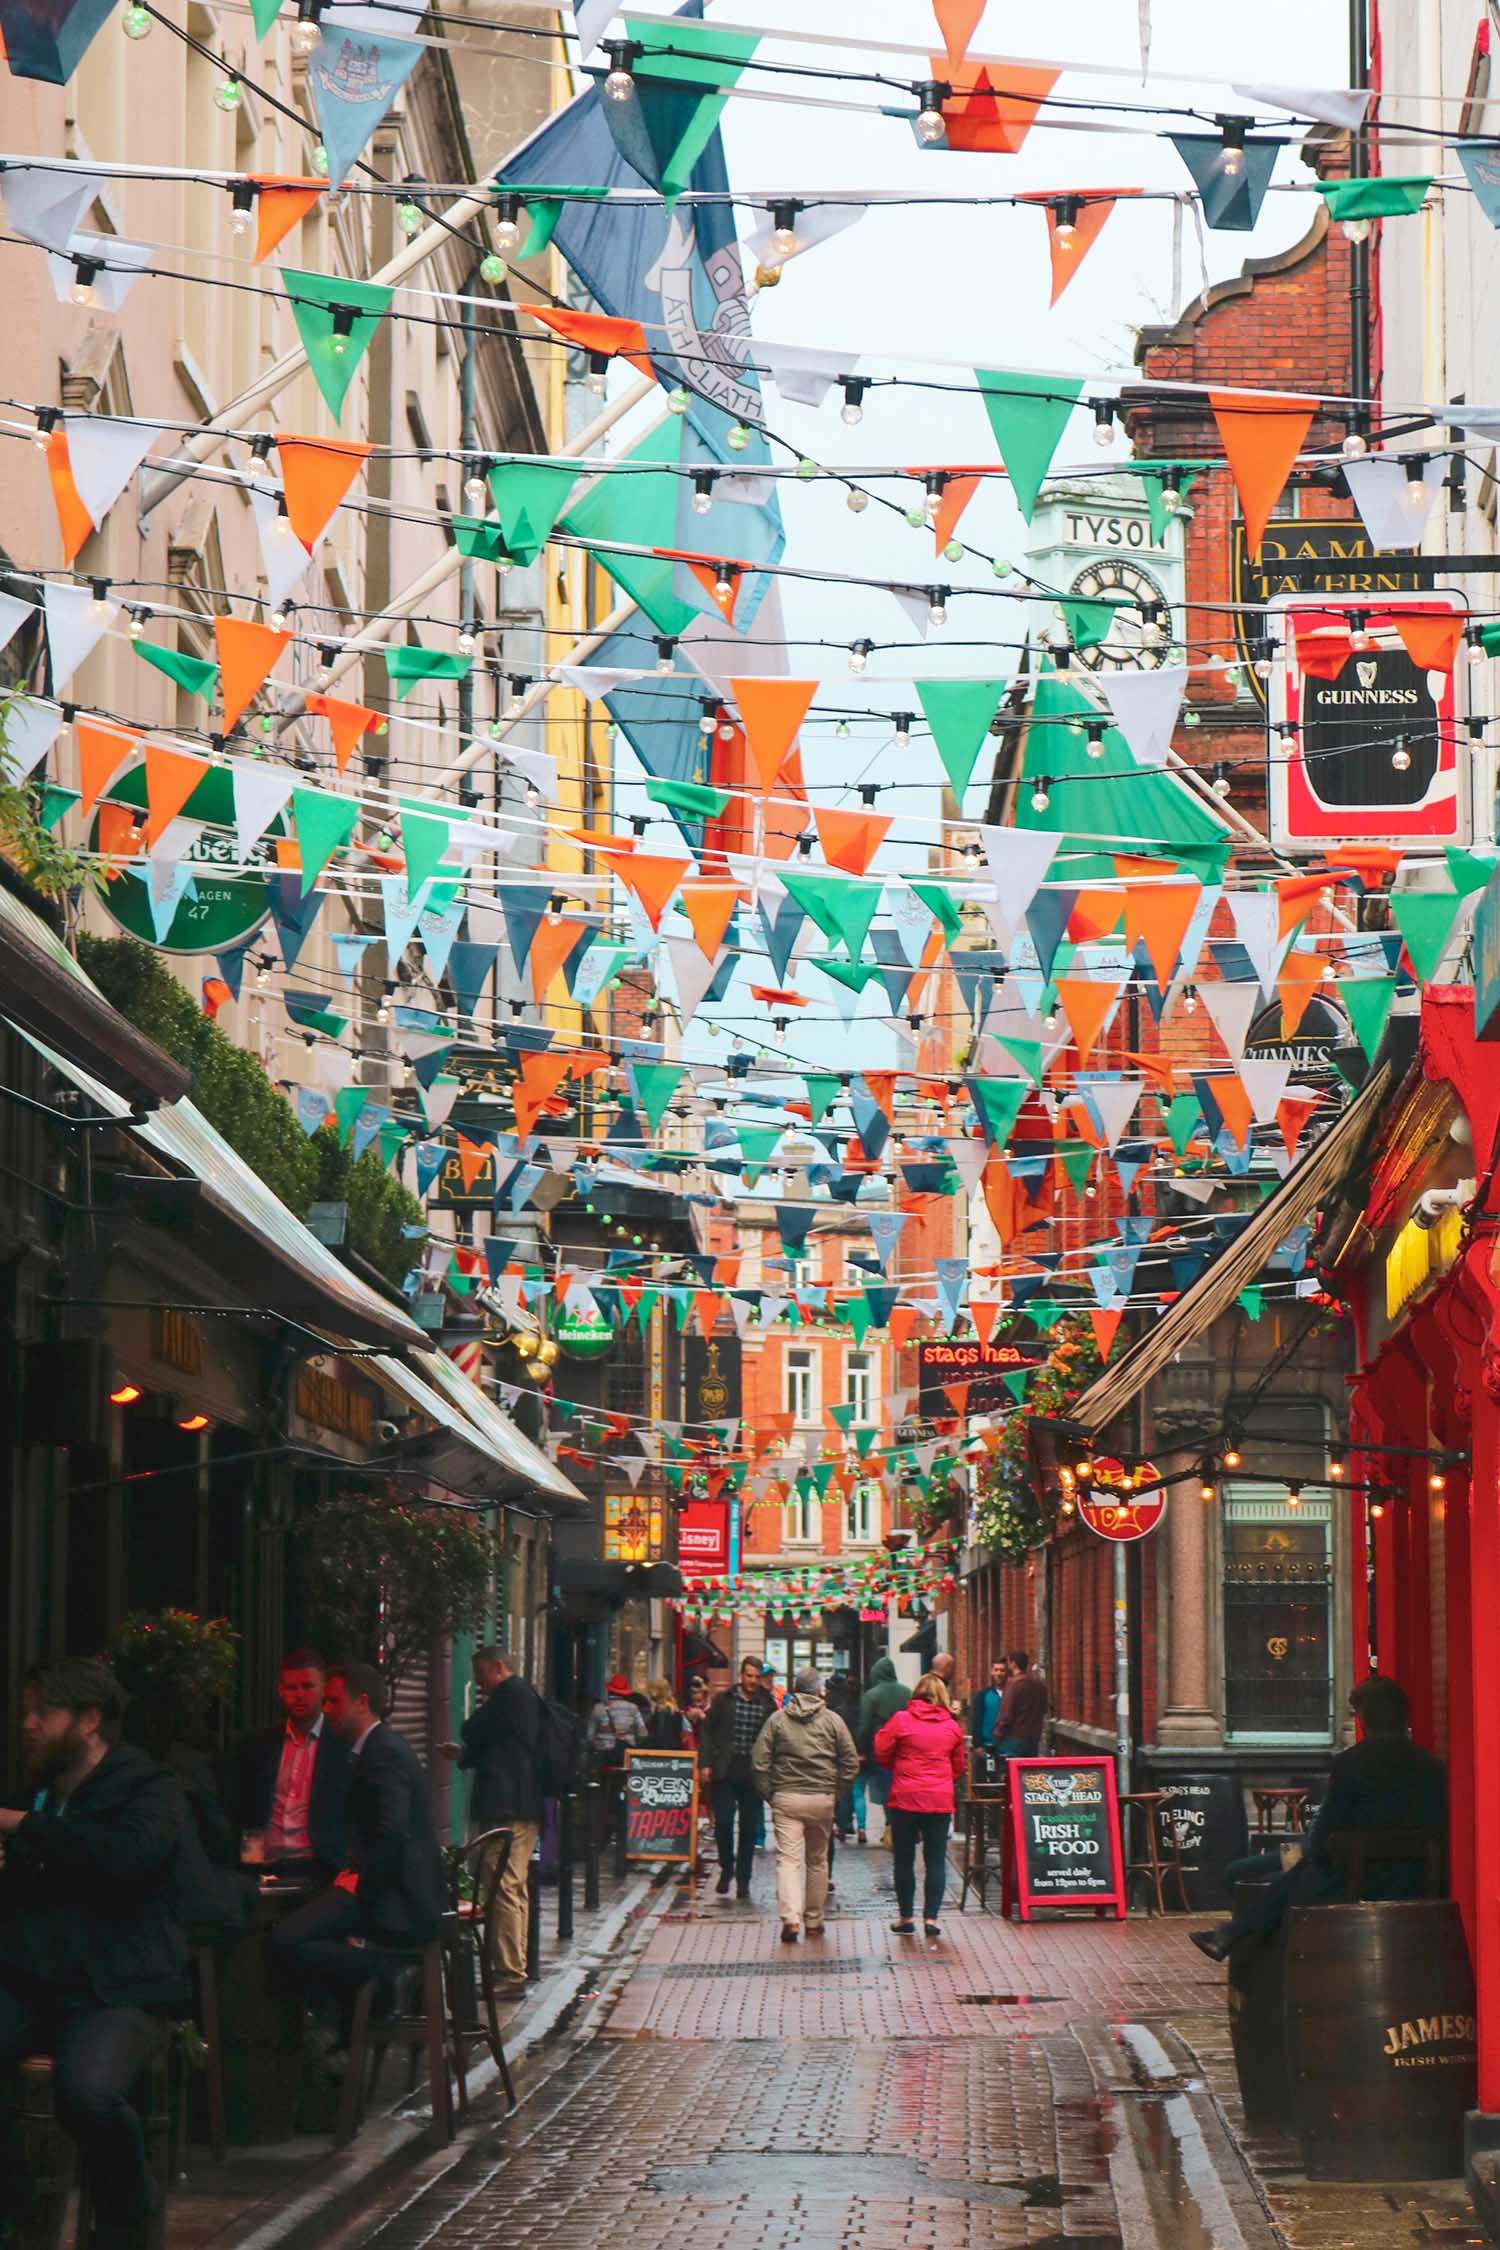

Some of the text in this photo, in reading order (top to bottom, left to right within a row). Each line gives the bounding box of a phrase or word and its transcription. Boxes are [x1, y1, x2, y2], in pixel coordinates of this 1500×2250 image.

[1251, 573, 1400, 598] TAERN
[1317, 690, 1418, 704] GUINNESS
[188, 906, 209, 919] 47
[1242, 1046, 1332, 1071] GUINNES
[558, 1329, 613, 1341] Heineken
[924, 1346, 979, 1366] stags
[628, 1776, 693, 1793] OPEN
[1024, 1791, 1102, 1802] STAG'S HEAD
[628, 1808, 692, 1839] TAPAS
[1032, 1815, 1080, 1842] IRISH
[1048, 1840, 1099, 1855] FOOD
[1073, 1867, 1092, 1877] daily
[1034, 1878, 1054, 1887] from
[1394, 2057, 1436, 2066] IRISH
